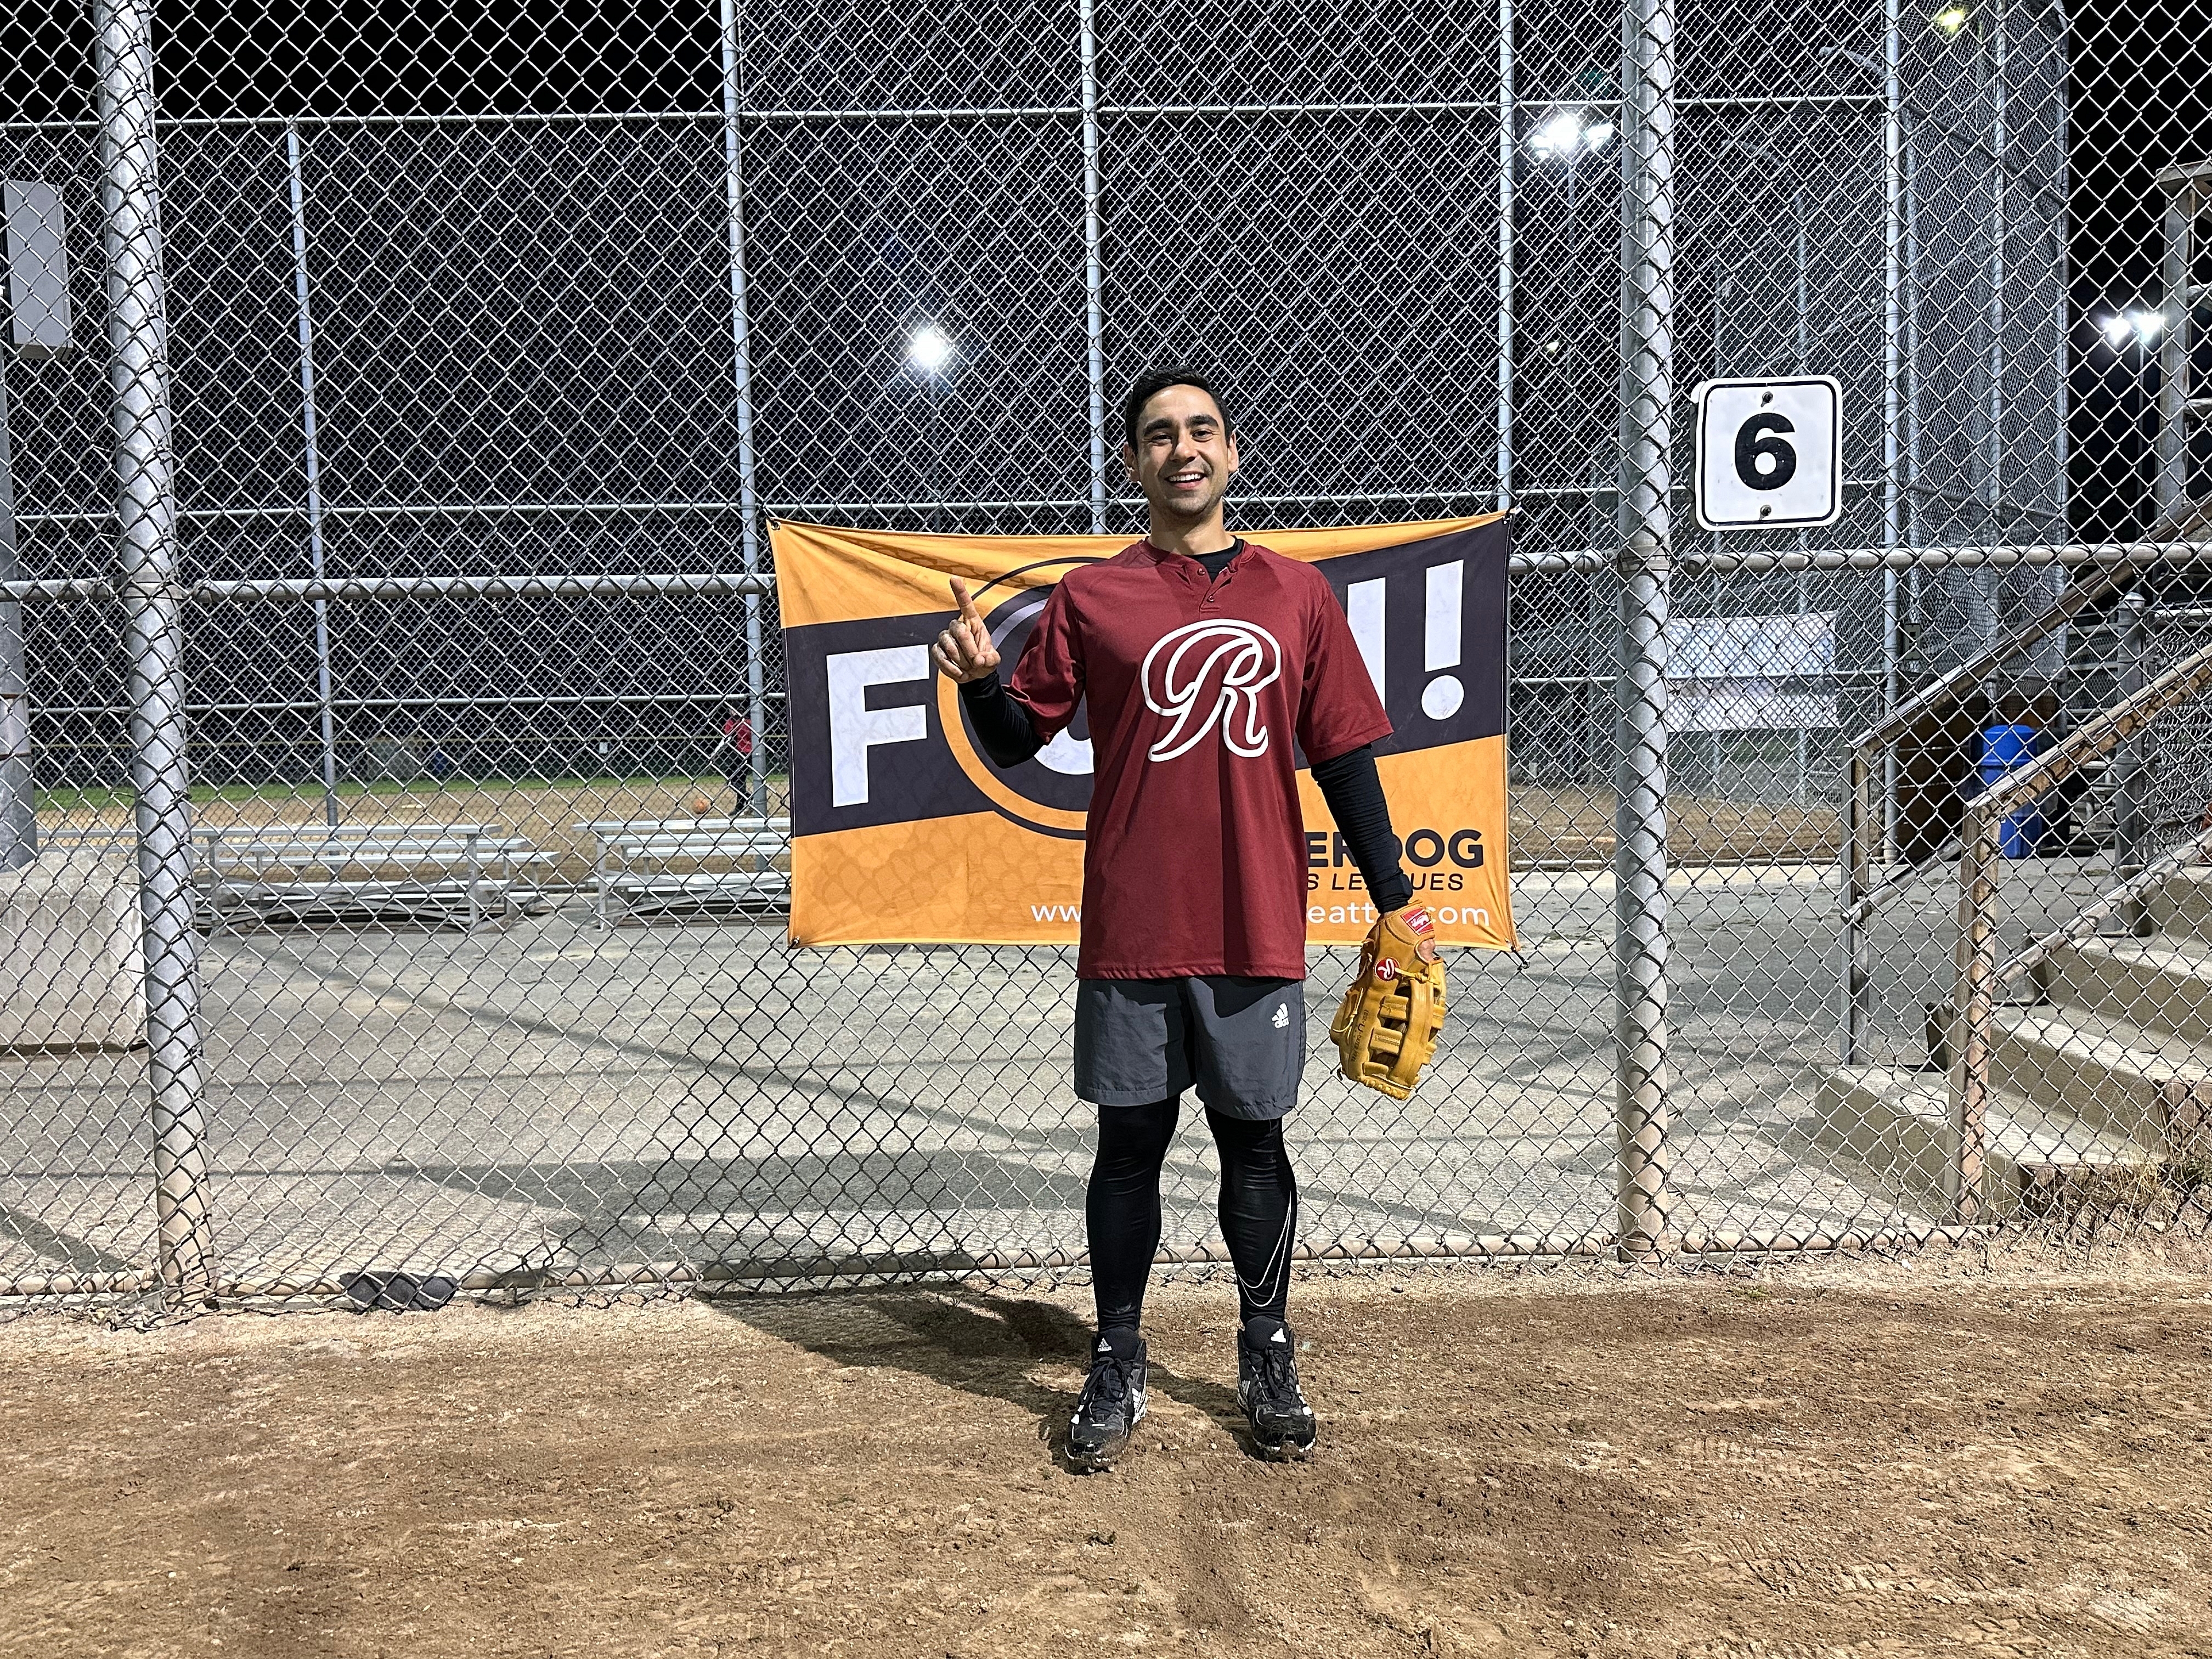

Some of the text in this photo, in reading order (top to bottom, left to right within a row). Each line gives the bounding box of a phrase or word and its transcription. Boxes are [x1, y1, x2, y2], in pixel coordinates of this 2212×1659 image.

[1734, 412, 1796, 490] 6
[1141, 618, 1281, 763] R
[1331, 873, 1464, 890] LEUES
